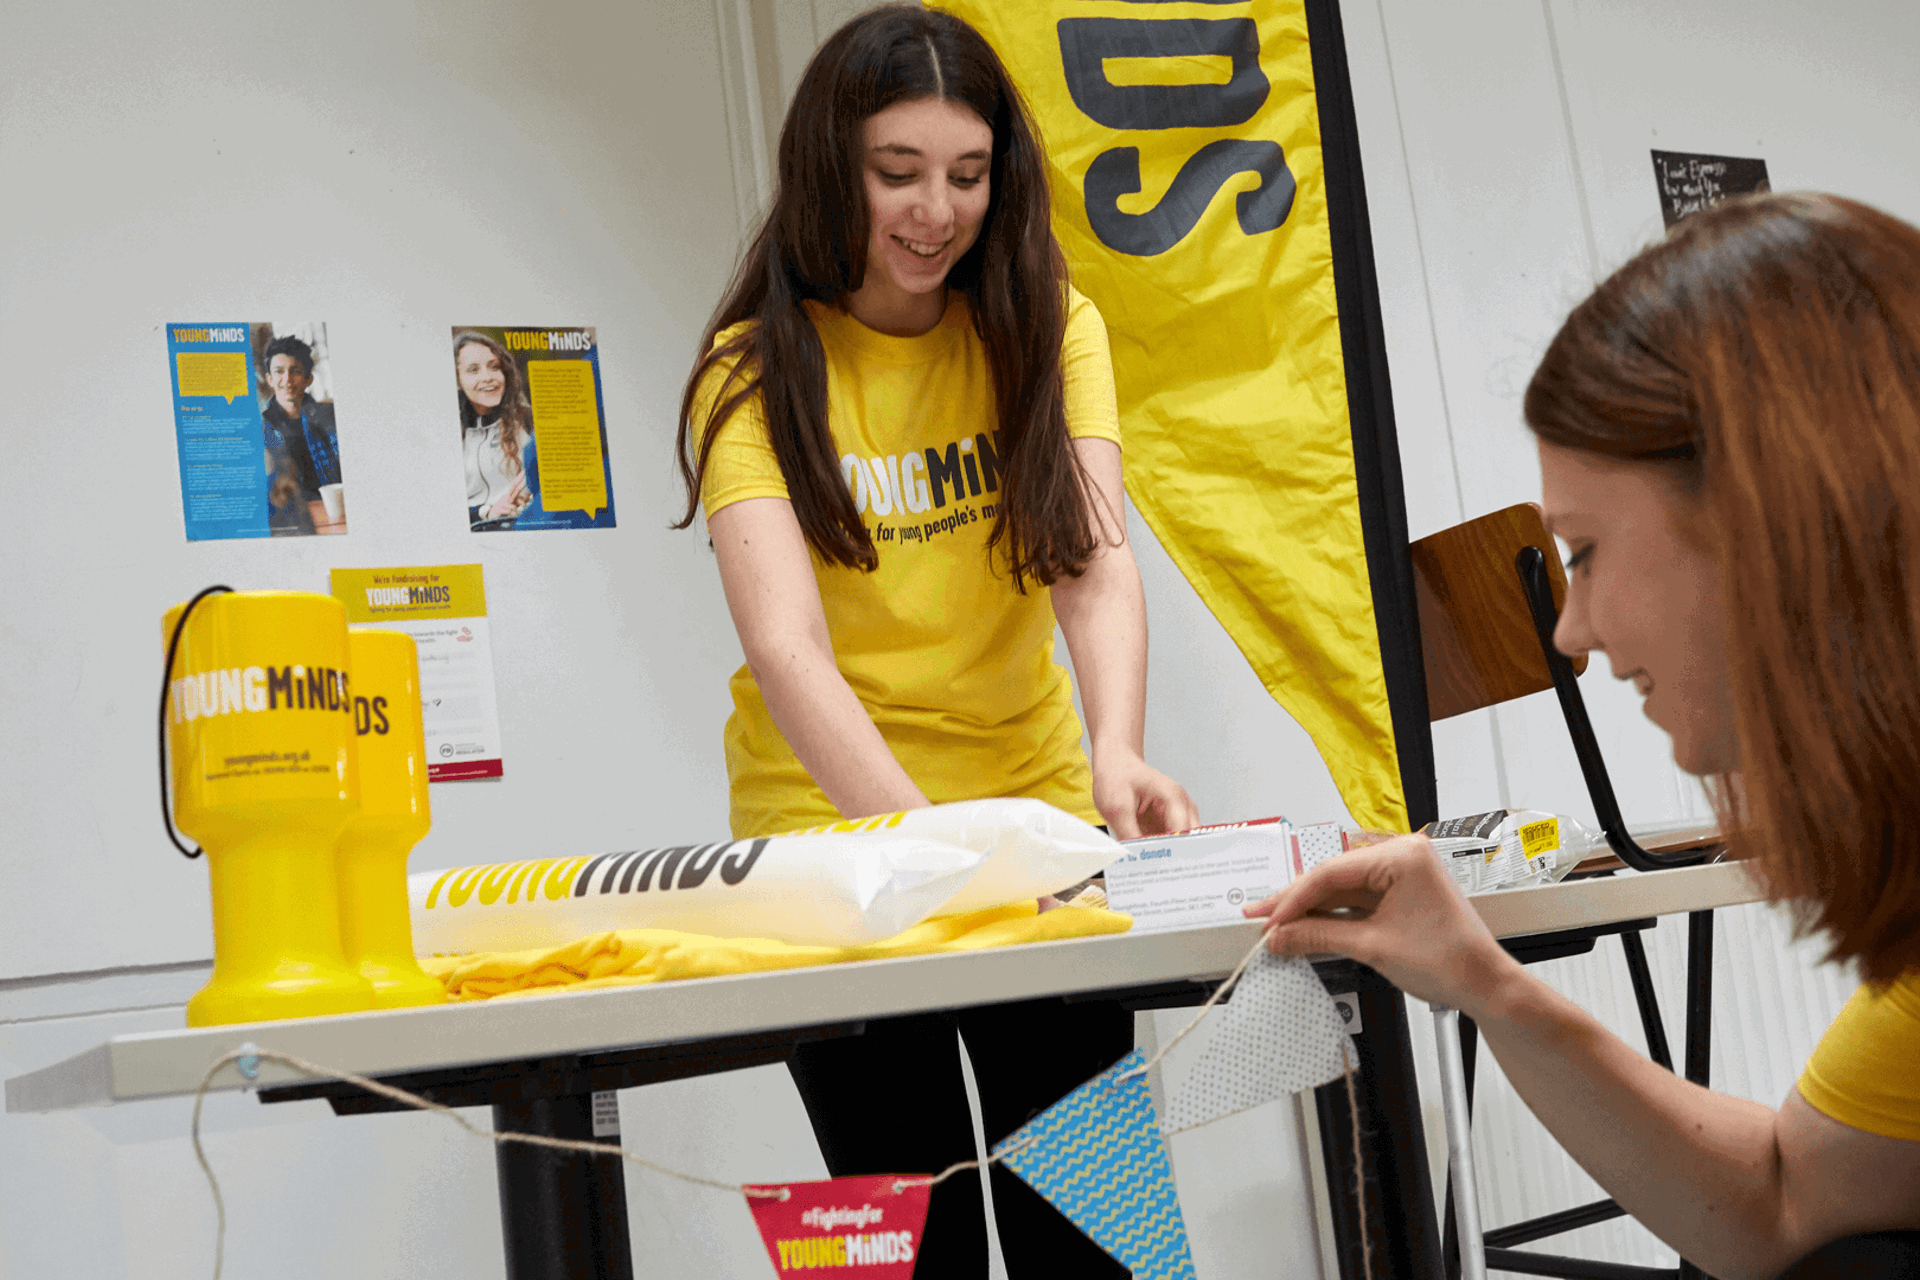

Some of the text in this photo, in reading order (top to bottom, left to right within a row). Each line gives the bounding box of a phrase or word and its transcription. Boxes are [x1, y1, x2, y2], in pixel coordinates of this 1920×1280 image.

[1056, 0, 1297, 257] DS
[877, 522, 896, 541] for
[924, 505, 978, 542] people's
[365, 585, 450, 606] YOUNGMiNDS
[355, 696, 394, 736] DS
[777, 1230, 914, 1271] YOUNGMiNDS
